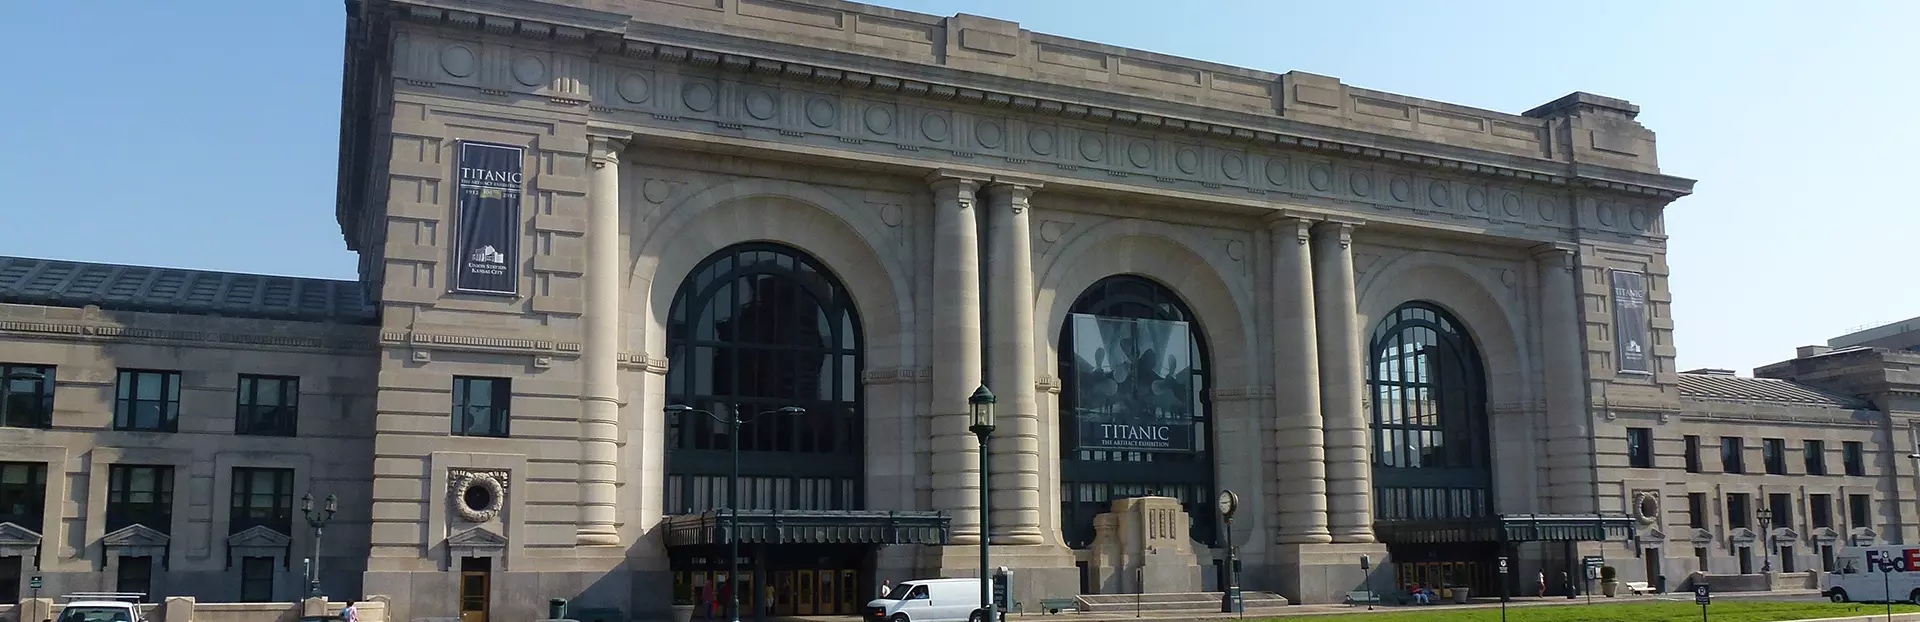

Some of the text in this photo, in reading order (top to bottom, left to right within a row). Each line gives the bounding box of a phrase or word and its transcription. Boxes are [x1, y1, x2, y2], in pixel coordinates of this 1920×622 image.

[461, 167, 523, 184] TITANIC
[1615, 287, 1643, 297] TITANIC
[1101, 424, 1170, 441] TITANIC
